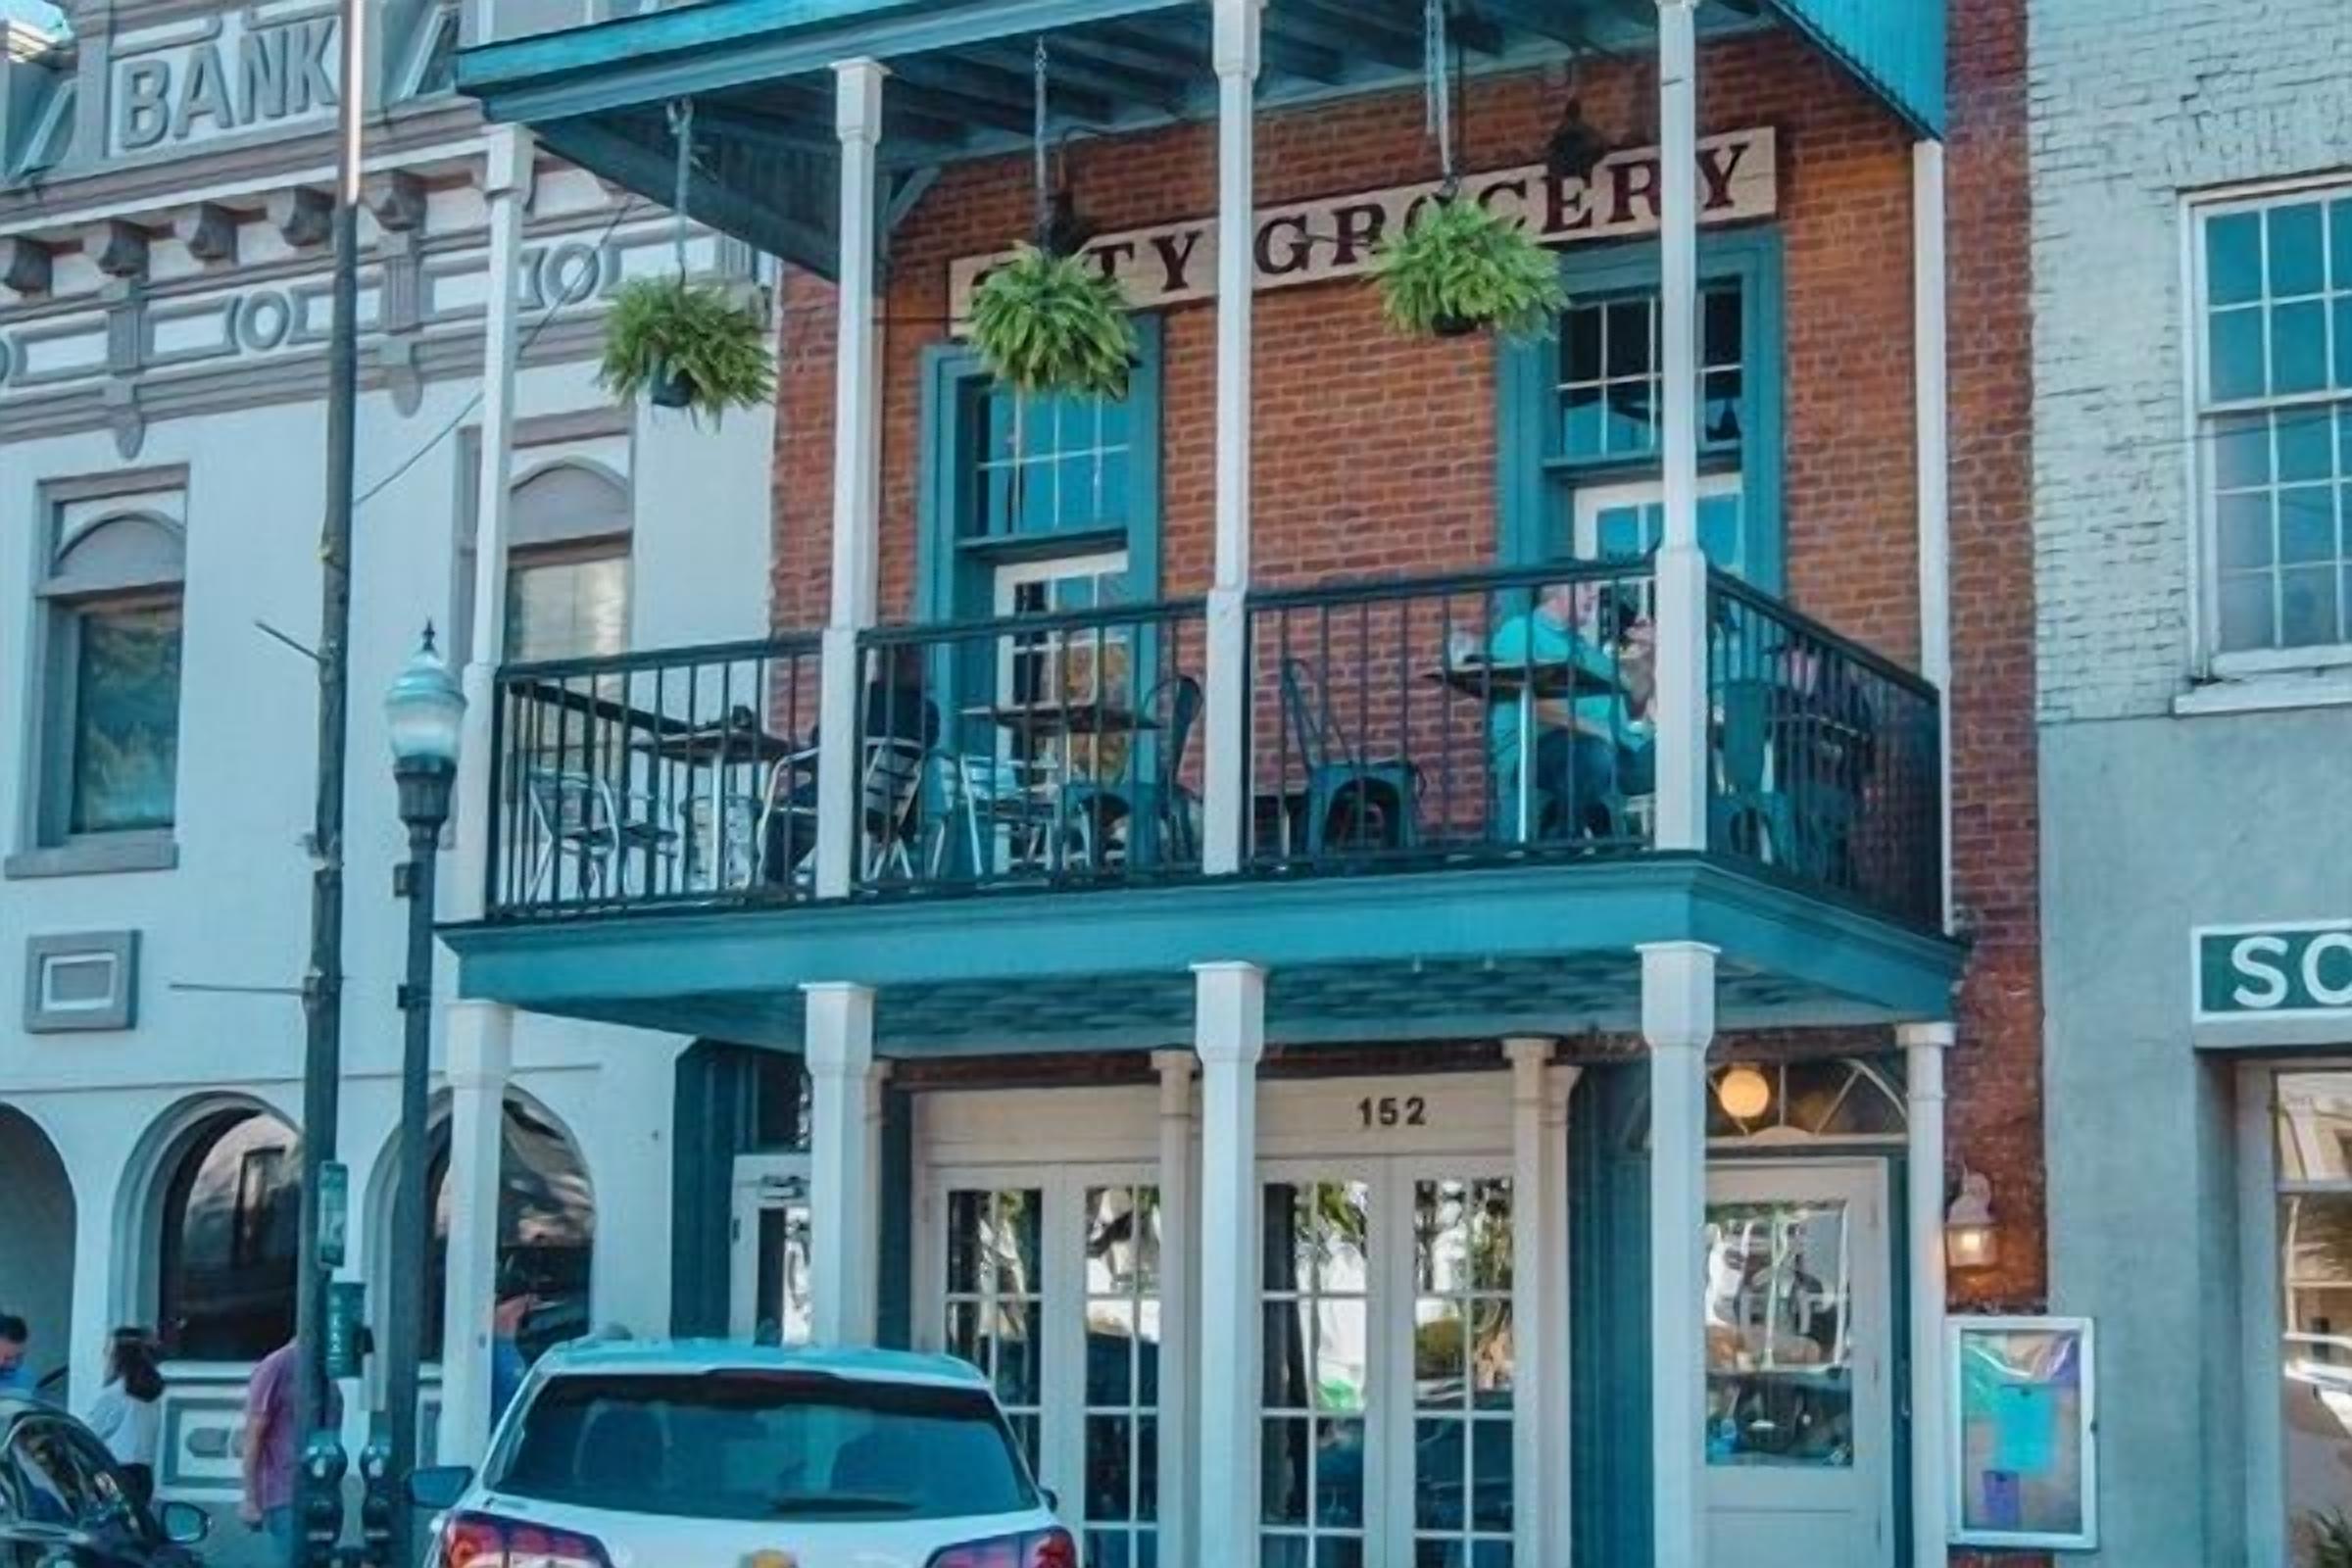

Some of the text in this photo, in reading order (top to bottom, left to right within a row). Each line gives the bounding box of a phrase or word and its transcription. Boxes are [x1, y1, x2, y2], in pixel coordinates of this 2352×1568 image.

[122, 18, 340, 149] BANK
[970, 229, 1203, 308] TY
[1357, 1096, 1426, 1126] 152
